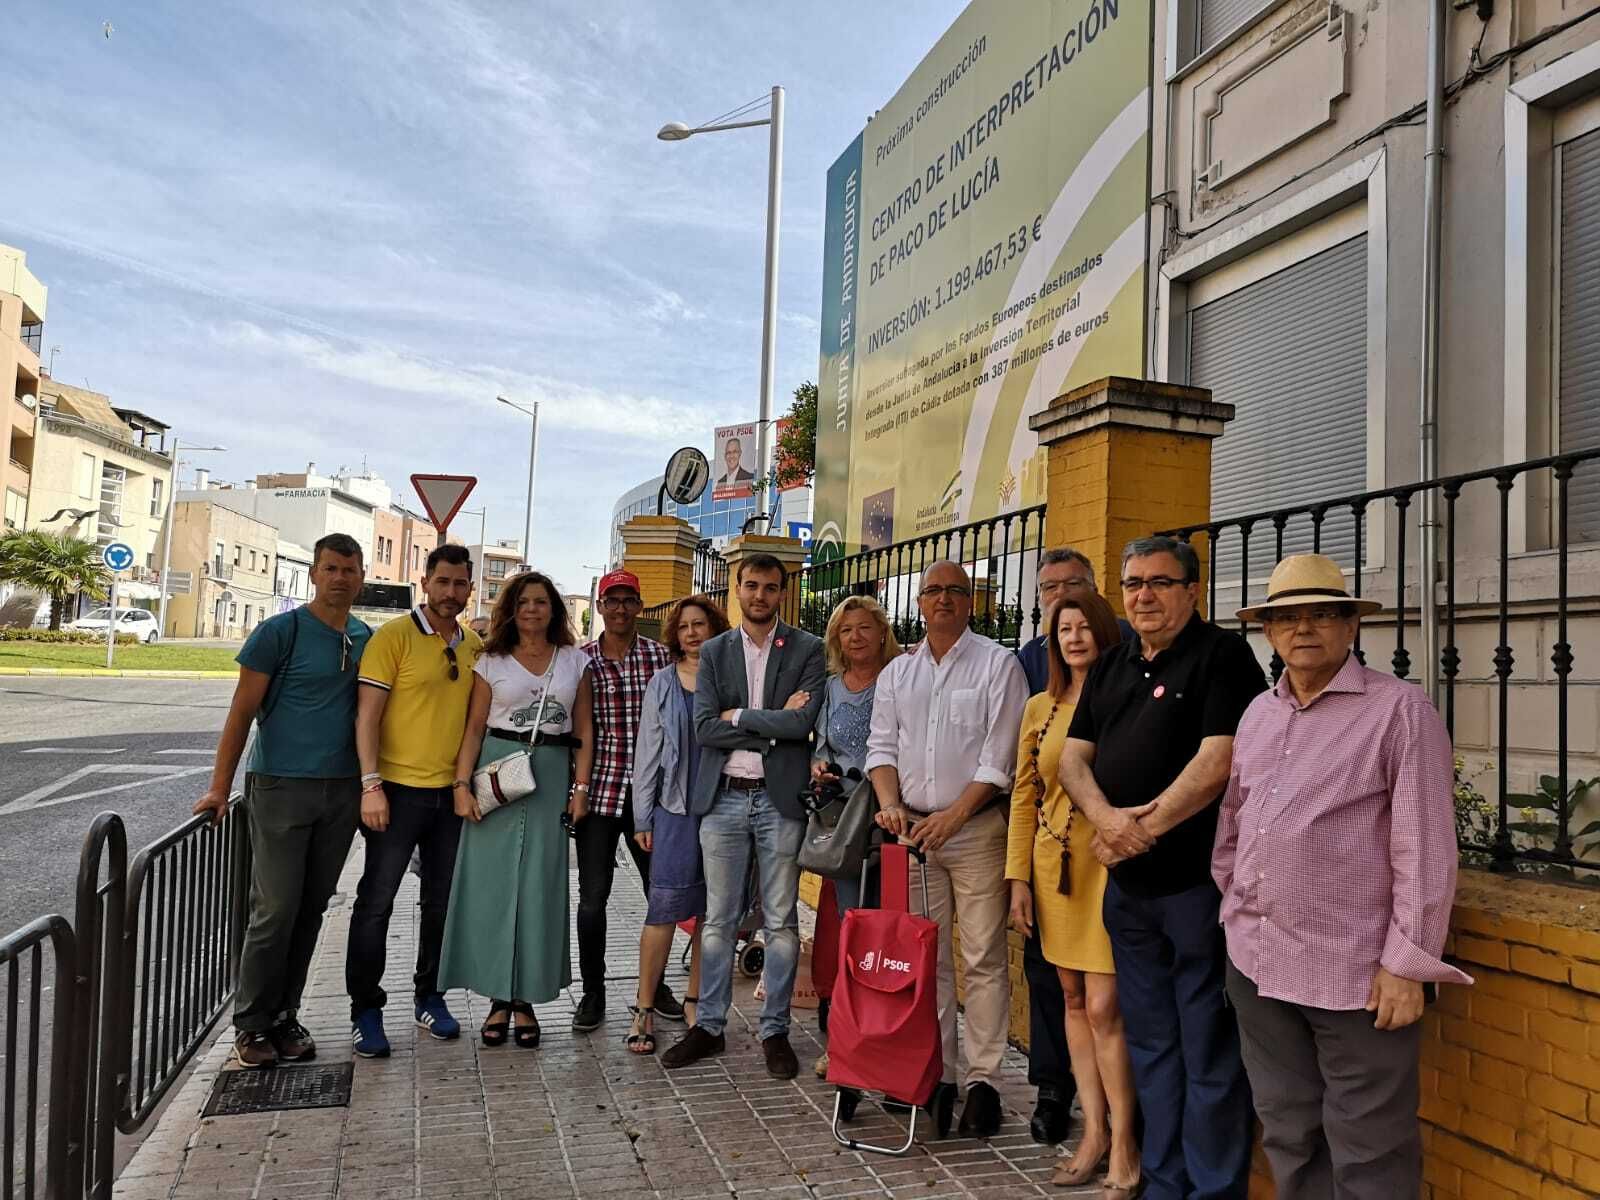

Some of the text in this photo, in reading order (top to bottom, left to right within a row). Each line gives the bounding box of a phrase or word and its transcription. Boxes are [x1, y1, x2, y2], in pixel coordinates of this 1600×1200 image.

[872, 0, 1118, 241] CENTRO DE INTERPRETACIÓN
[876, 35, 986, 168] Próxima construcción
[870, 155, 1000, 287] DE PACO DE LUCÍA
[840, 312, 851, 347] DE
[868, 214, 1042, 354] INVERSIÓN: 1.199.467,53 €
[931, 348, 944, 366] por
[945, 340, 957, 355] los
[959, 320, 990, 346] Fondos
[992, 292, 1037, 327] Europeos
[1039, 253, 1103, 299] destinados
[836, 353, 849, 433] JUNTA
[865, 403, 884, 420] desde
[885, 399, 892, 409] la
[893, 388, 911, 406] Junta
[912, 383, 921, 396] de
[962, 358, 968, 369] a
[970, 352, 978, 365] la
[981, 327, 1023, 358] Inversión
[1026, 291, 1081, 334] Territorial
[865, 418, 894, 441] Integrada
[911, 406, 919, 420] de
[921, 394, 941, 414] Cádiz
[943, 380, 971, 402] dotada
[972, 372, 989, 387] con
[991, 359, 1009, 379] 387
[1011, 339, 1054, 369] millones
[1057, 330, 1072, 346] de
[1075, 311, 1109, 338] euros
[718, 426, 753, 438] VOTA PSOE
[284, 489, 326, 498] FARMACIA
[798, 527, 812, 547] P
[883, 957, 911, 973] PSOE
